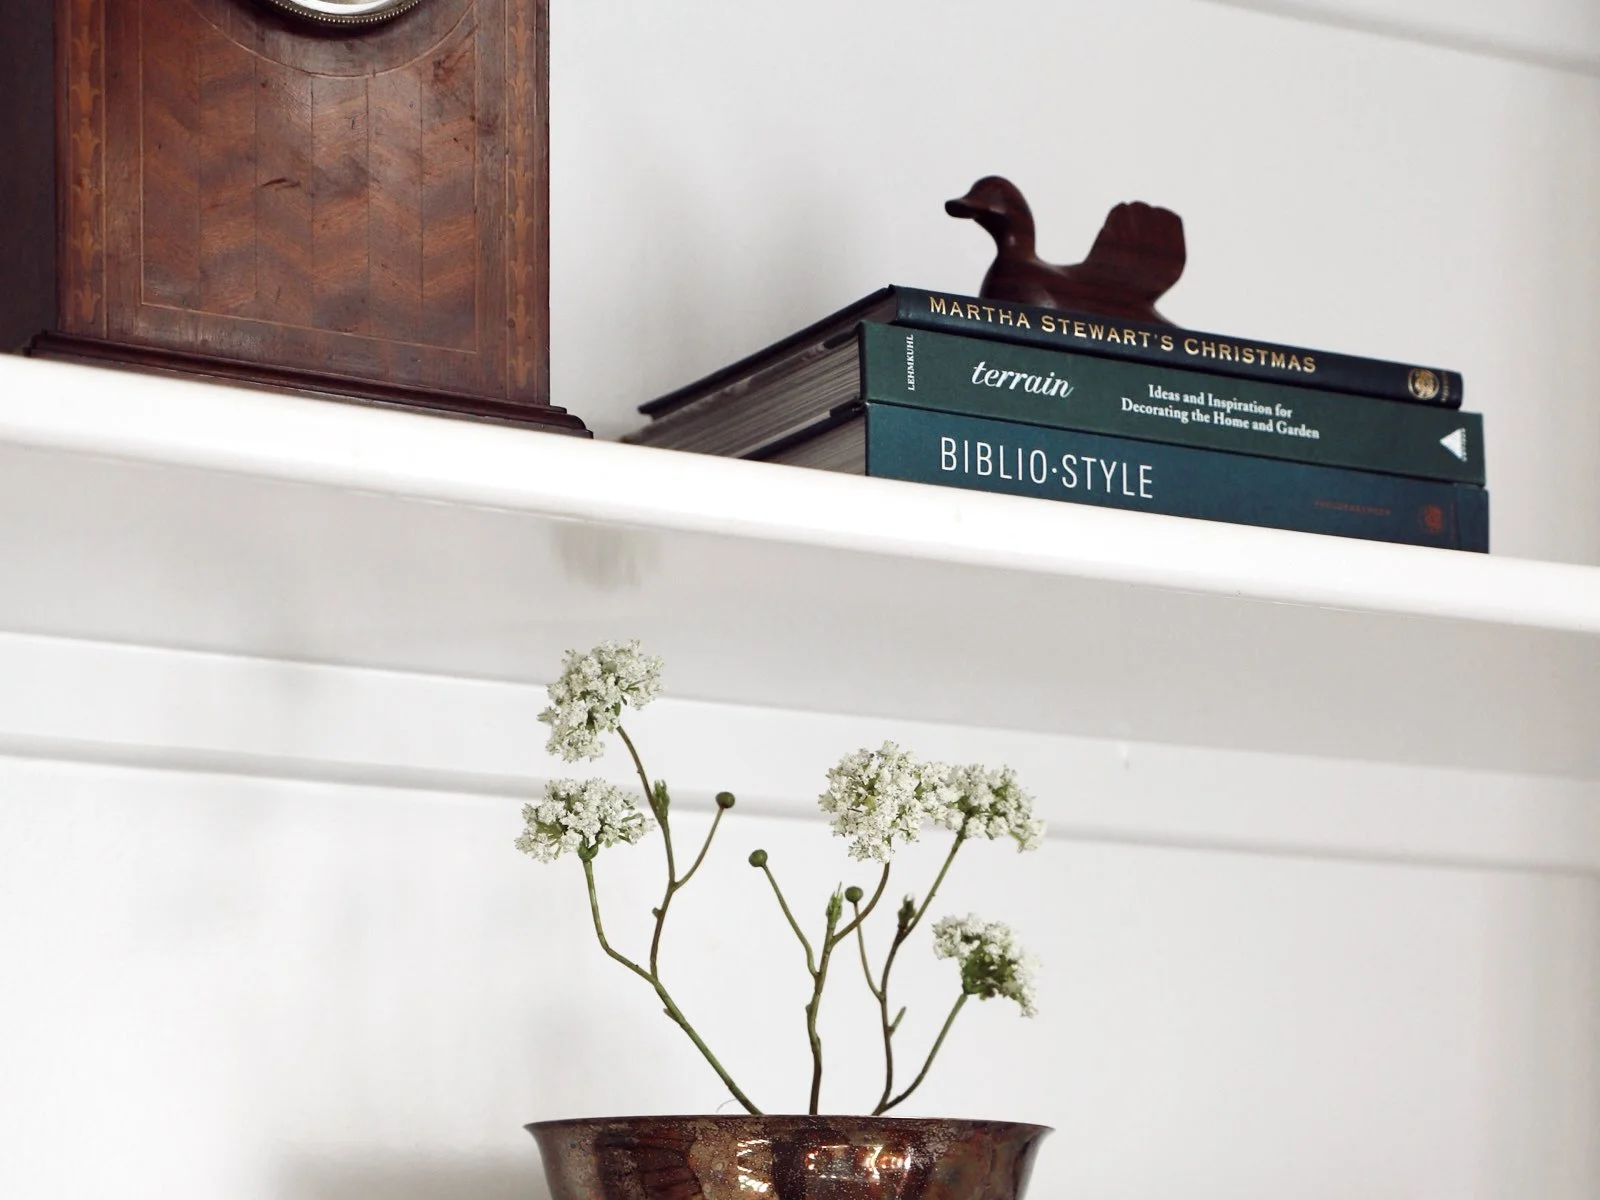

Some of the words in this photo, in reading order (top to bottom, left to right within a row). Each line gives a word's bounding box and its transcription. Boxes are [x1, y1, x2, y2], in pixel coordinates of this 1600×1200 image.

[929, 296, 1031, 329] MARTHA
[1041, 315, 1174, 352] STEWART'S
[1184, 338, 1317, 374] CHRISTMAS
[907, 334, 916, 391] LEHMKUHL
[970, 360, 1075, 398] terrain
[1120, 397, 1189, 424] Decorating
[1191, 410, 1210, 423] the
[1213, 411, 1250, 429] Home
[1252, 419, 1273, 433] and
[1276, 421, 1320, 440] Garden
[1148, 384, 1180, 401] Ideas
[1182, 391, 1205, 405] and
[1207, 393, 1273, 416] Inspiration
[1274, 404, 1293, 419] for
